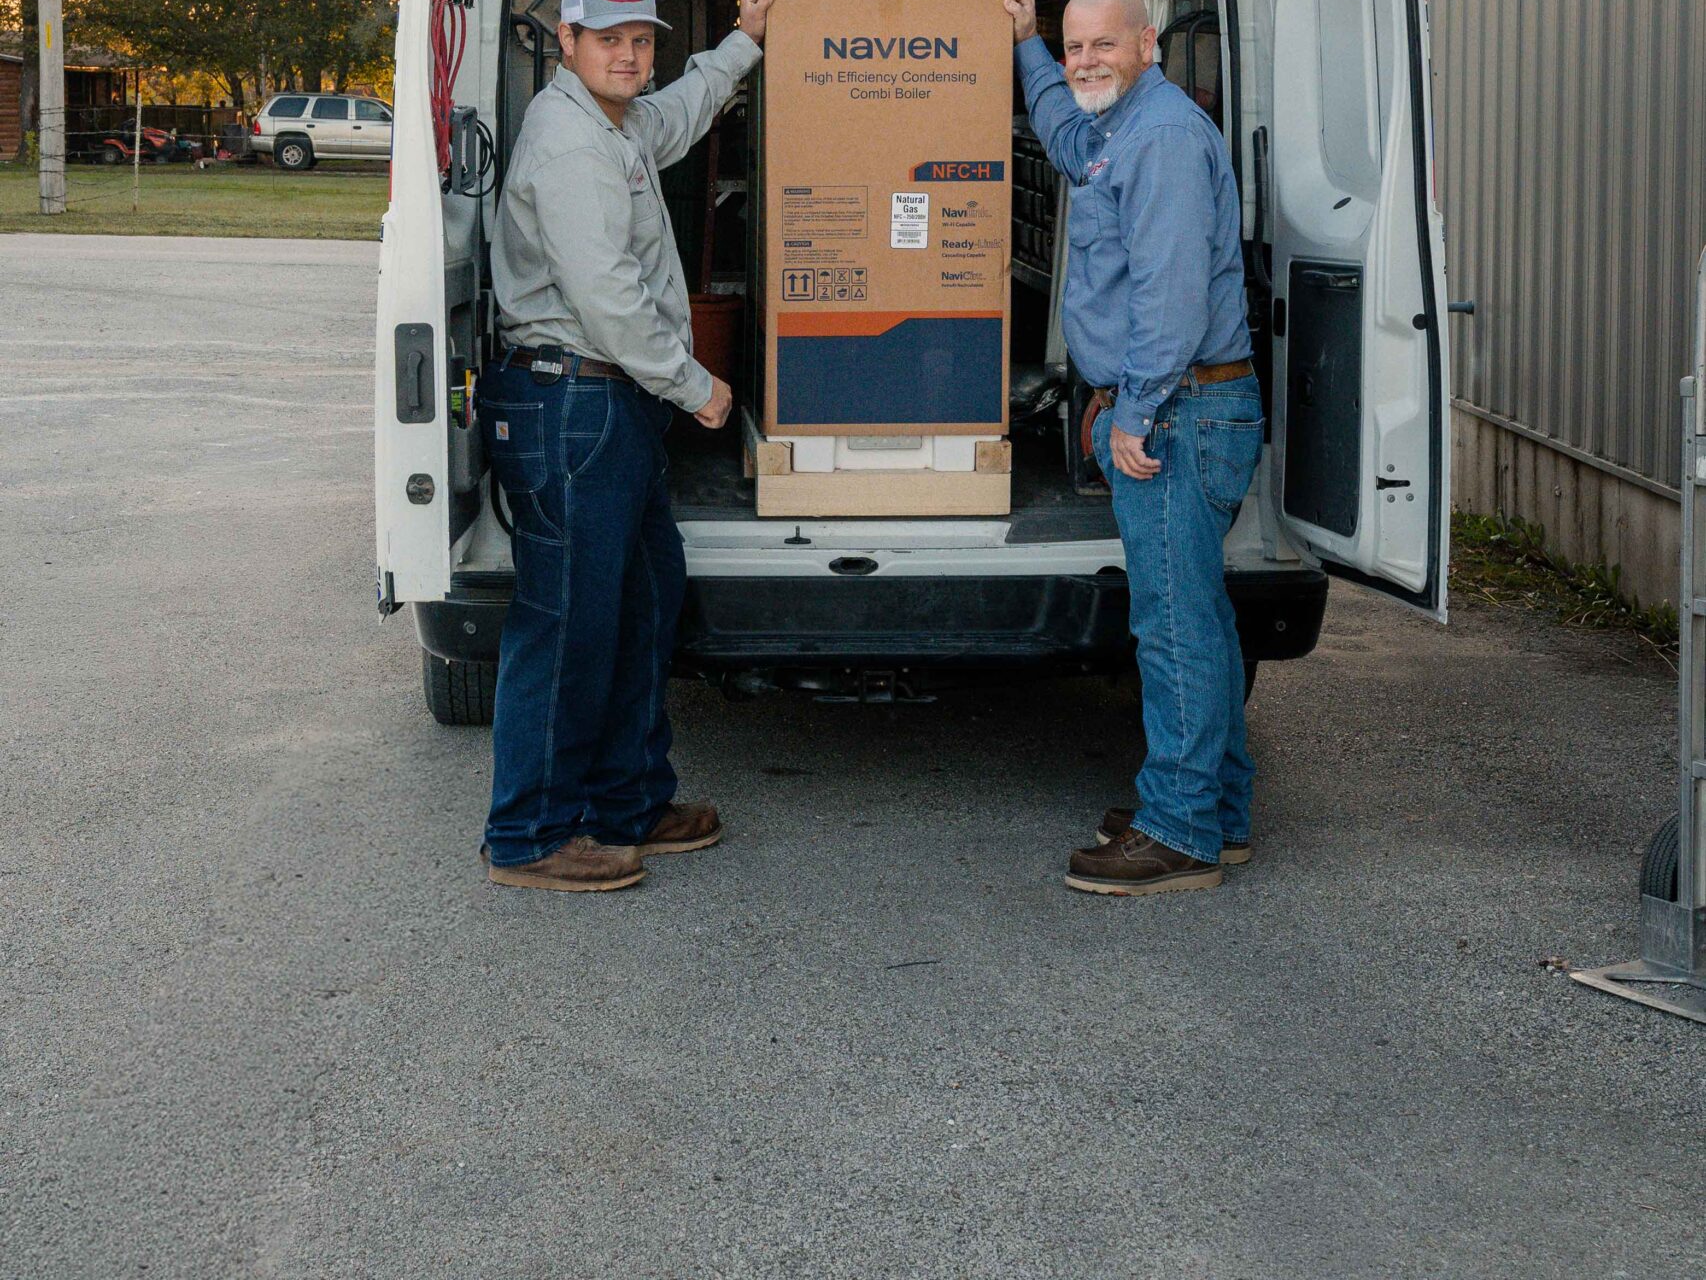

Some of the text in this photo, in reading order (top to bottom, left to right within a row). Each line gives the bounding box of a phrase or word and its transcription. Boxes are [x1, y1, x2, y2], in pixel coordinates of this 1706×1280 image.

[804, 70, 977, 85] High Efficiency Condensing
[850, 88, 932, 99] Combi Boiler
[932, 163, 991, 179] NFC-H
[896, 195, 926, 204] Natural
[903, 204, 919, 213] Gas
[822, 287, 828, 296] 2
